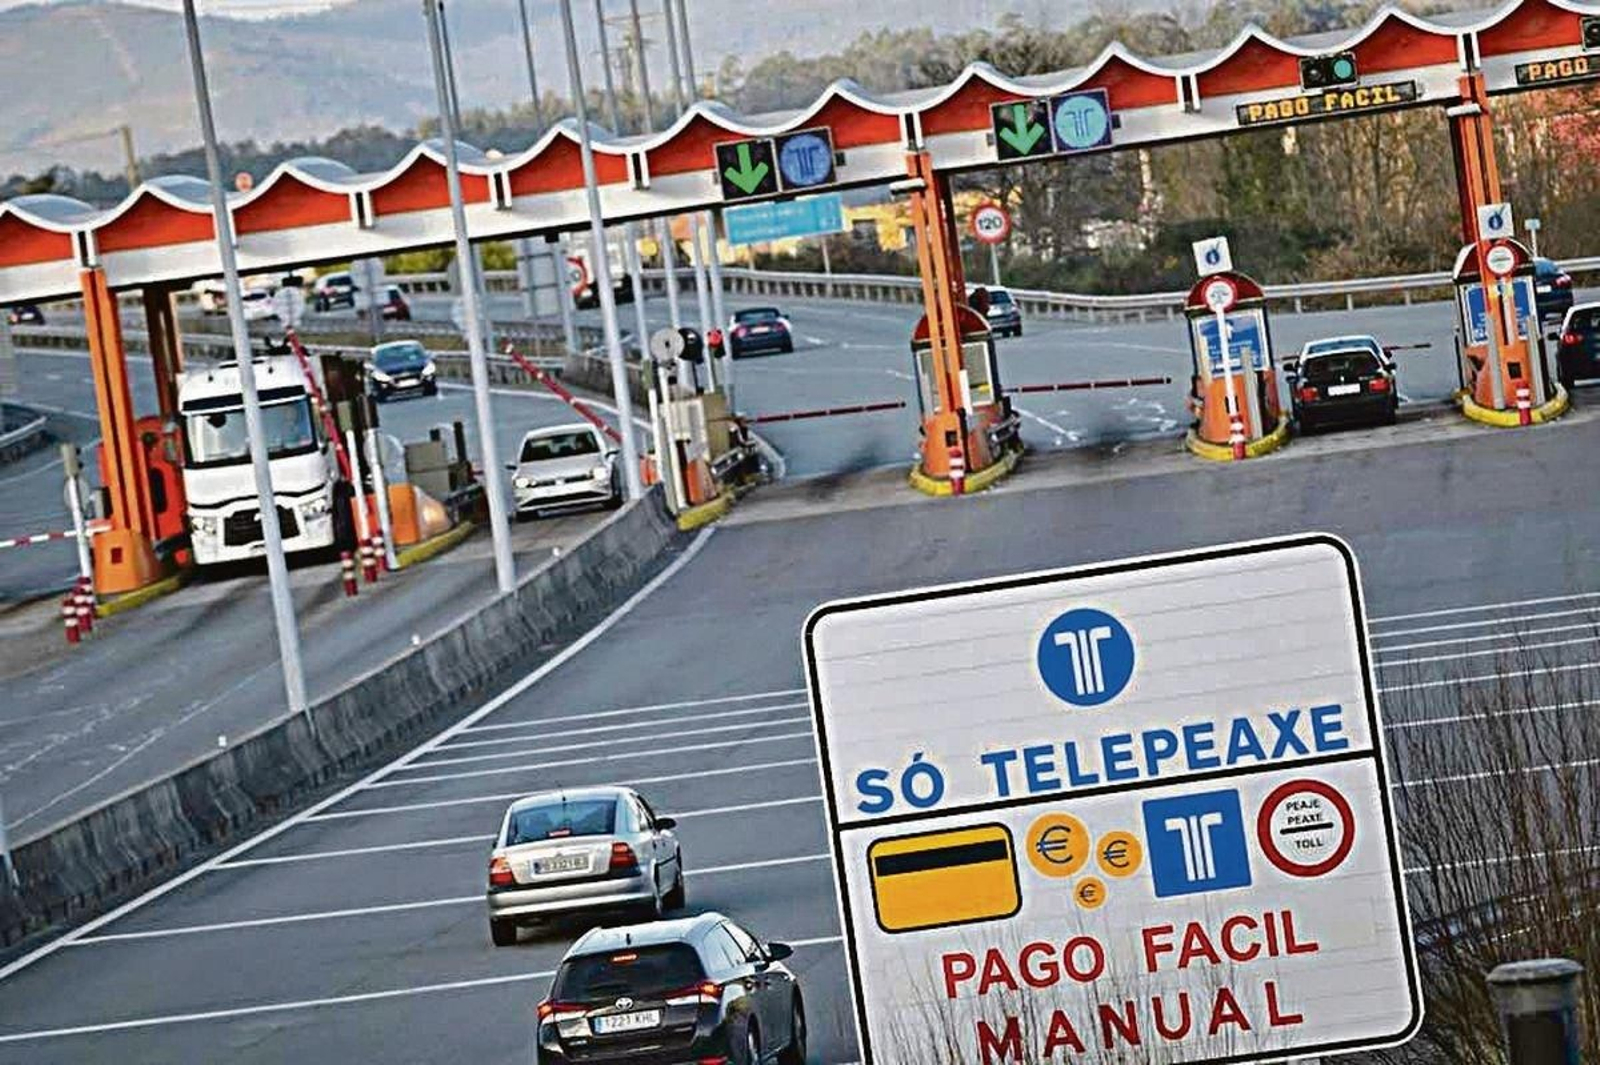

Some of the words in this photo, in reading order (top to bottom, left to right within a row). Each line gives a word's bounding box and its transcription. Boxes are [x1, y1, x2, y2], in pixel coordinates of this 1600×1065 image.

[1528, 57, 1590, 81] PAGO
[1248, 97, 1309, 121] PAGO
[1325, 86, 1401, 110] FACIL
[978, 216, 1003, 230] 120
[857, 751, 944, 813] SÓ
[982, 705, 1348, 797] TELEPEAXE
[1286, 799, 1321, 812] PEAJE
[1287, 813, 1323, 825] PEAXE
[1295, 837, 1323, 849] TOLL
[943, 936, 1105, 998] PAGO
[1143, 910, 1319, 973] FACIL
[978, 981, 1303, 1065] MANUAL
